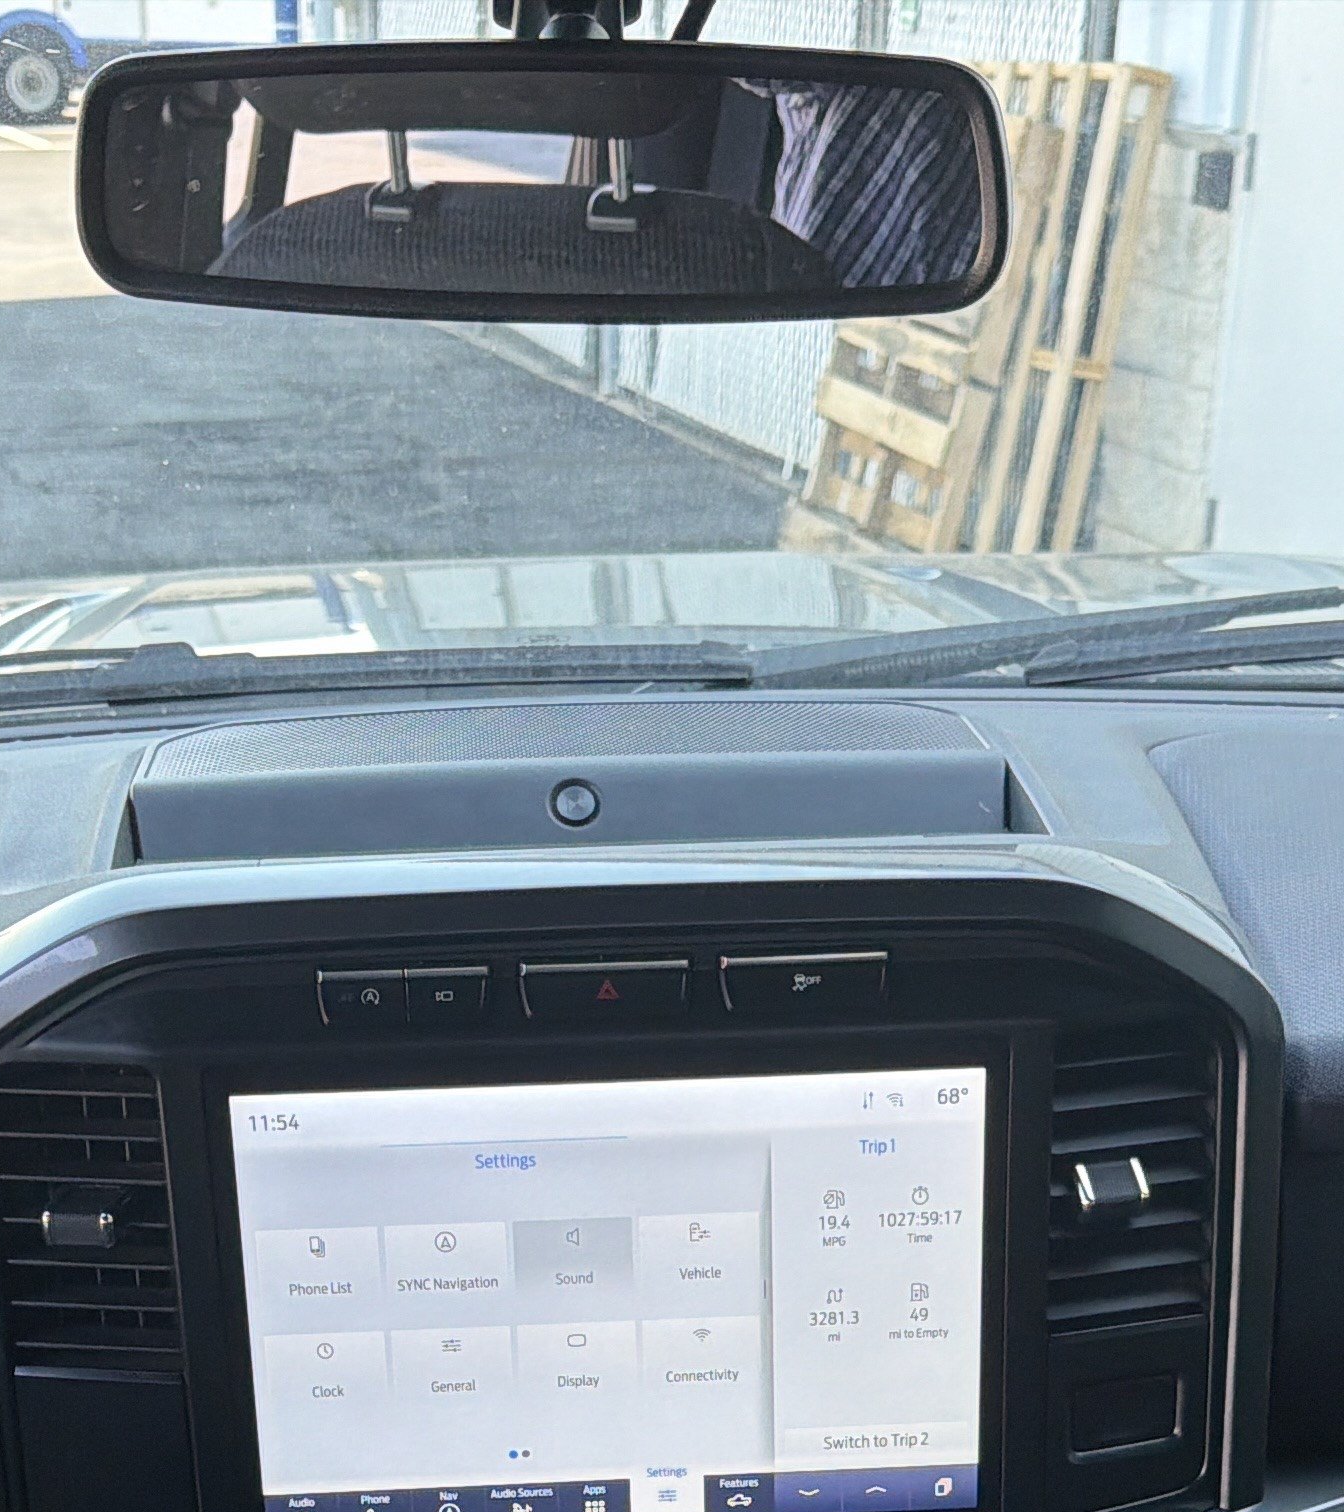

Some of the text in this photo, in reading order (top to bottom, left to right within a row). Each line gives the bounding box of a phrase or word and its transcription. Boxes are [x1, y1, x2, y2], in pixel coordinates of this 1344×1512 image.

[937, 1087, 969, 1105] 68°
[248, 1113, 300, 1132] 11:54
[859, 1138, 896, 1157] Trip 1
[474, 1153, 537, 1171] Settings
[818, 1214, 851, 1230] 19.4
[878, 1209, 962, 1228] 1027:59:17
[822, 1235, 846, 1248] MPG
[906, 1232, 933, 1244] Time
[555, 1271, 594, 1286] Sound
[678, 1266, 722, 1280] Vehicle
[289, 1281, 352, 1296] Phone List
[397, 1275, 499, 1292] SYNC Navigation
[808, 1310, 859, 1327] 3281.3
[909, 1307, 929, 1322] 49
[828, 1331, 841, 1342] mi
[889, 1327, 949, 1342] mi to Empty
[557, 1374, 600, 1389] Display
[665, 1368, 739, 1384] Connectivity
[312, 1385, 344, 1398] Clock
[431, 1379, 476, 1393] General
[823, 1432, 929, 1450] Switch to Trip 2
[646, 1466, 687, 1480] Settings
[719, 1477, 759, 1489] Features
[439, 1491, 458, 1501] Nav
[490, 1487, 553, 1499] Audio Sources
[583, 1485, 606, 1497] Apps
[288, 1497, 315, 1508] Audio
[360, 1494, 390, 1506] Phone
